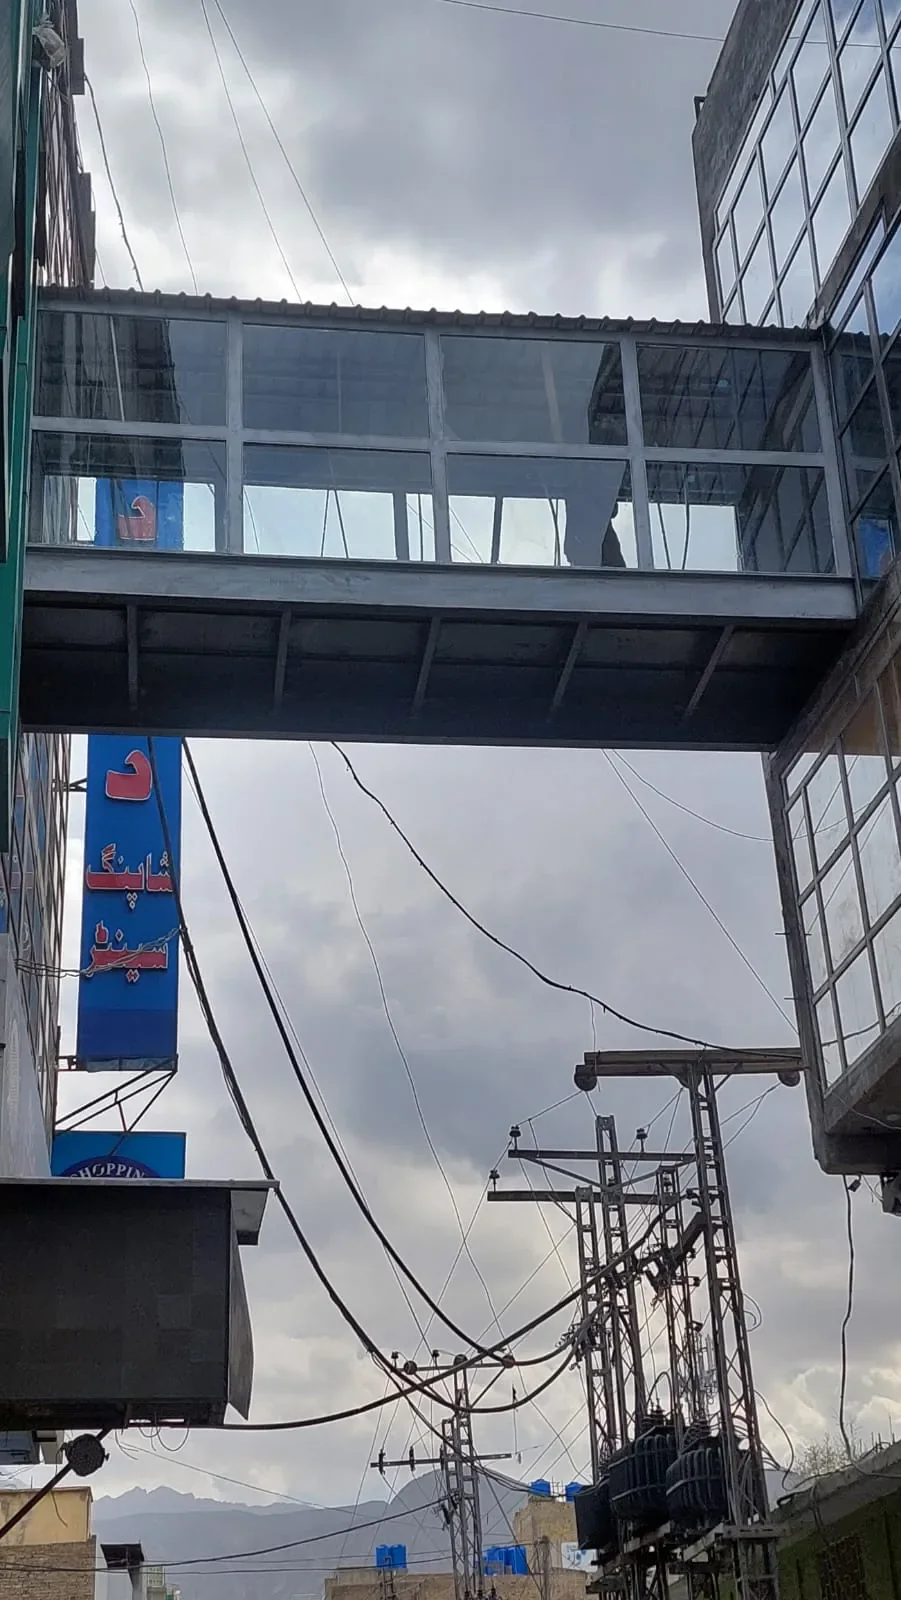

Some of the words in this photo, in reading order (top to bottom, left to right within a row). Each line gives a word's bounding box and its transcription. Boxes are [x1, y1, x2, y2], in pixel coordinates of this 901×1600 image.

[86, 843, 174, 910] شاپنگ
[86, 920, 169, 982] سینٹر
[70, 1162, 146, 1178] HOPPIN
